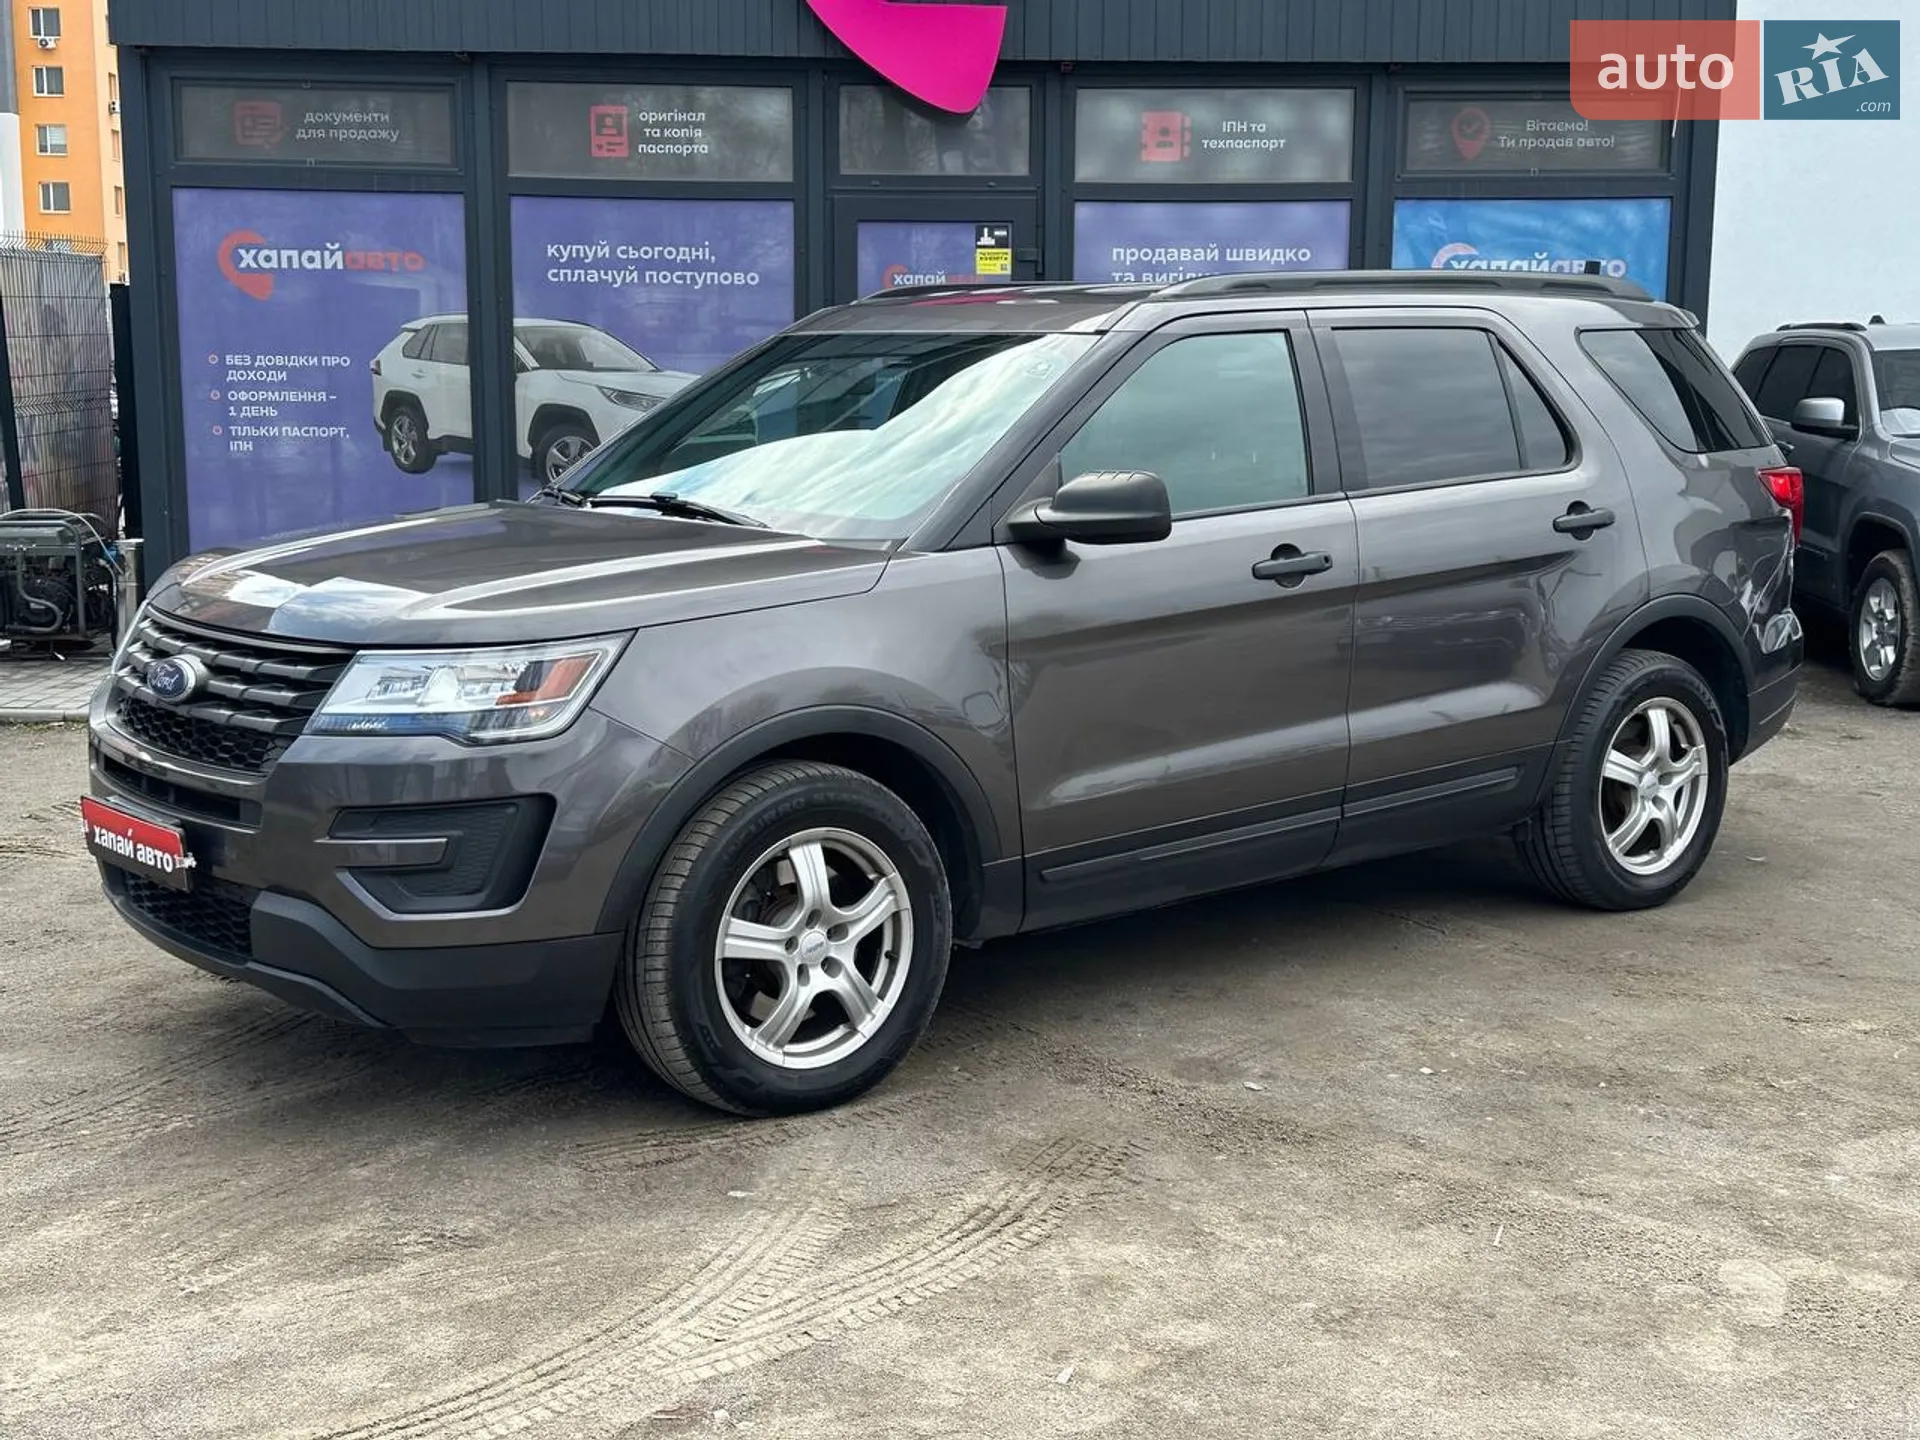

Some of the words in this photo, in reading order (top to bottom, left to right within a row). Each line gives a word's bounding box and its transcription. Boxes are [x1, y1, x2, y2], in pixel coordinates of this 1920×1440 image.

[304, 111, 390, 125] документи
[639, 109, 706, 124] оригінал
[643, 127, 661, 138] та
[664, 125, 702, 138] копія
[1222, 120, 1248, 133] ІПН
[1249, 123, 1266, 133] та
[1526, 119, 1589, 132] Вітаємо!
[296, 128, 325, 140] для
[329, 128, 399, 142] продажу
[638, 143, 709, 157] паспорта
[1201, 138, 1286, 151] техпаспорт
[1499, 135, 1515, 148] Ти
[1519, 137, 1574, 151] продав
[1576, 135, 1615, 148] авто!
[547, 240, 610, 263] купуй
[616, 241, 716, 264] сьогодні,
[1112, 243, 1219, 265] продавай
[1225, 248, 1311, 265] швидко
[547, 265, 639, 288] сплачуй
[645, 270, 760, 289] поступово
[1112, 271, 1135, 282] та
[225, 354, 252, 366] БЕЗ
[254, 355, 319, 368] ДОВІДКИ
[321, 355, 351, 367] ПРО
[226, 370, 287, 382] ДОХОДИ
[227, 390, 326, 402] ОФОРМЛЕННЯ
[228, 406, 237, 417] 1
[240, 406, 278, 418] ДЕНЬ
[229, 426, 279, 437] ТІЛЬКИ
[281, 427, 350, 439] ПАСПОРТ,
[230, 440, 253, 451] ІПН
[152, 664, 180, 691] Ford
[93, 825, 135, 859] хапай
[136, 843, 174, 873] авто
